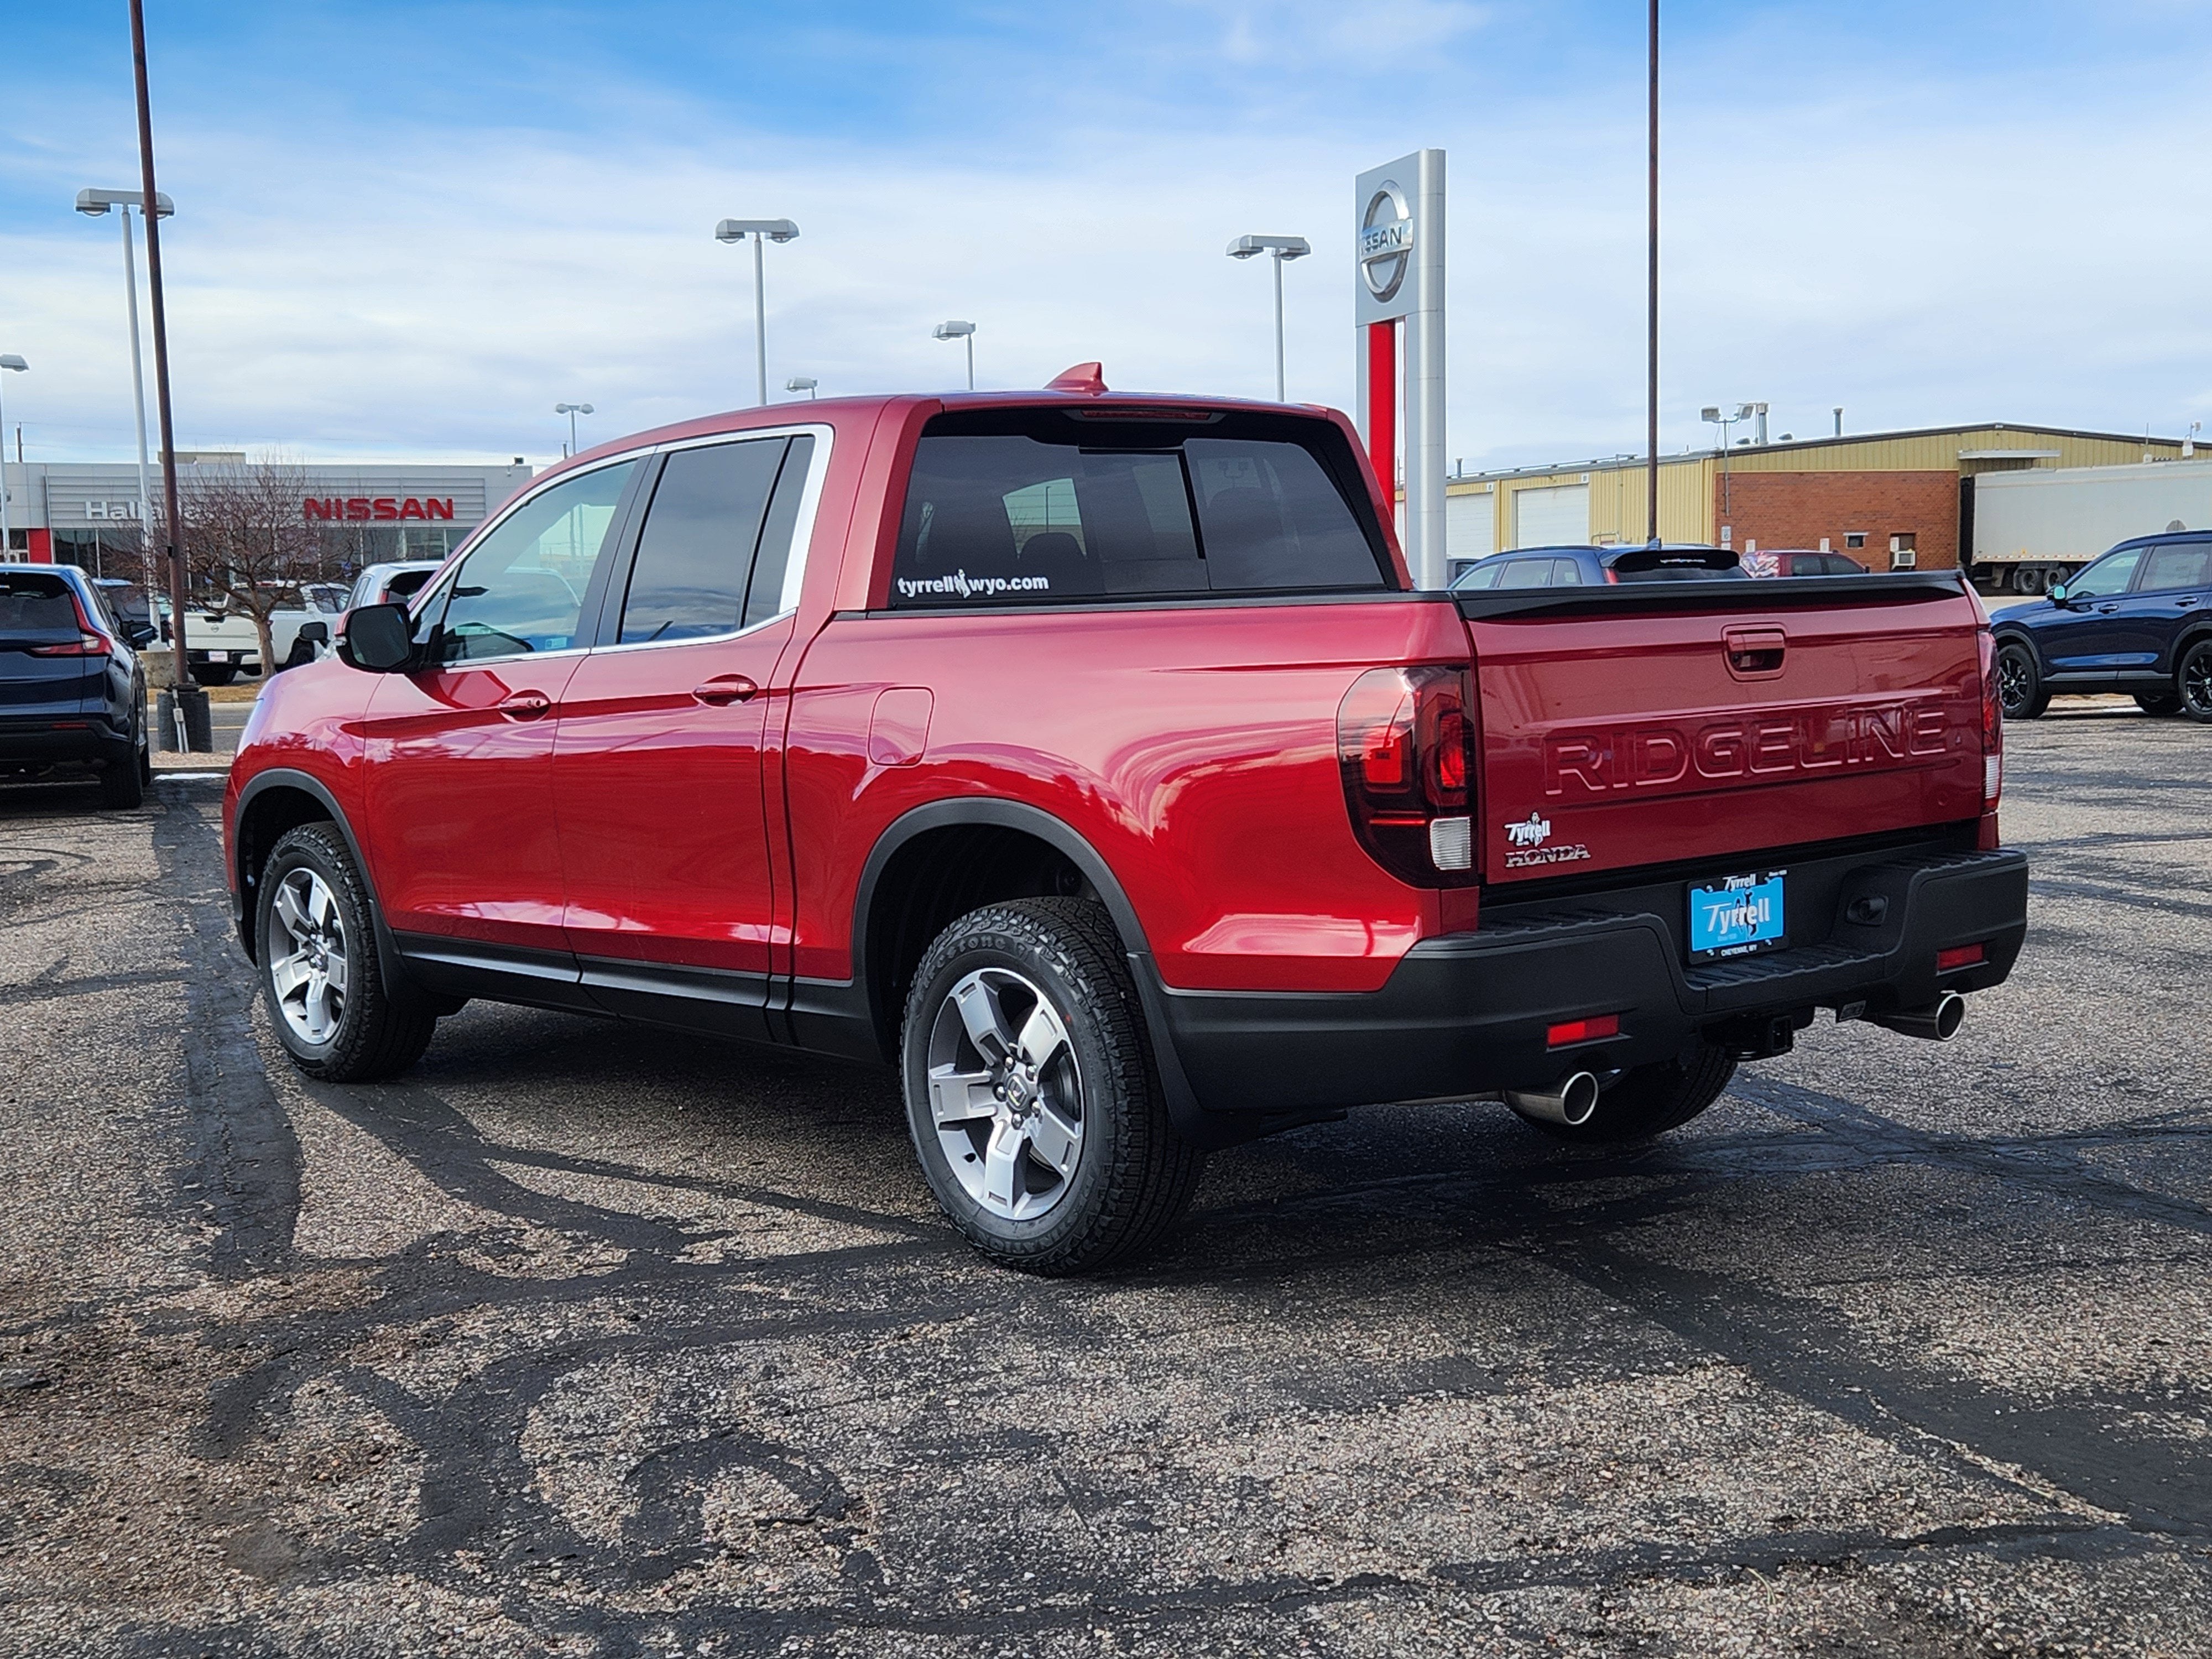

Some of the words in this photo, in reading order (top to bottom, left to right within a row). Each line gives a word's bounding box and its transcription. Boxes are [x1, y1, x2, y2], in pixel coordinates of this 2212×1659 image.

[1361, 226, 1402, 256] SSAN
[304, 498, 453, 520] NISSAN
[1543, 701, 1947, 795] RIDGELINE
[1505, 844, 1592, 868] HONDA
[1722, 873, 1756, 891] Tyrrell
[1702, 897, 1771, 935] Tyrrell
[916, 932, 1006, 1003] Firestone
